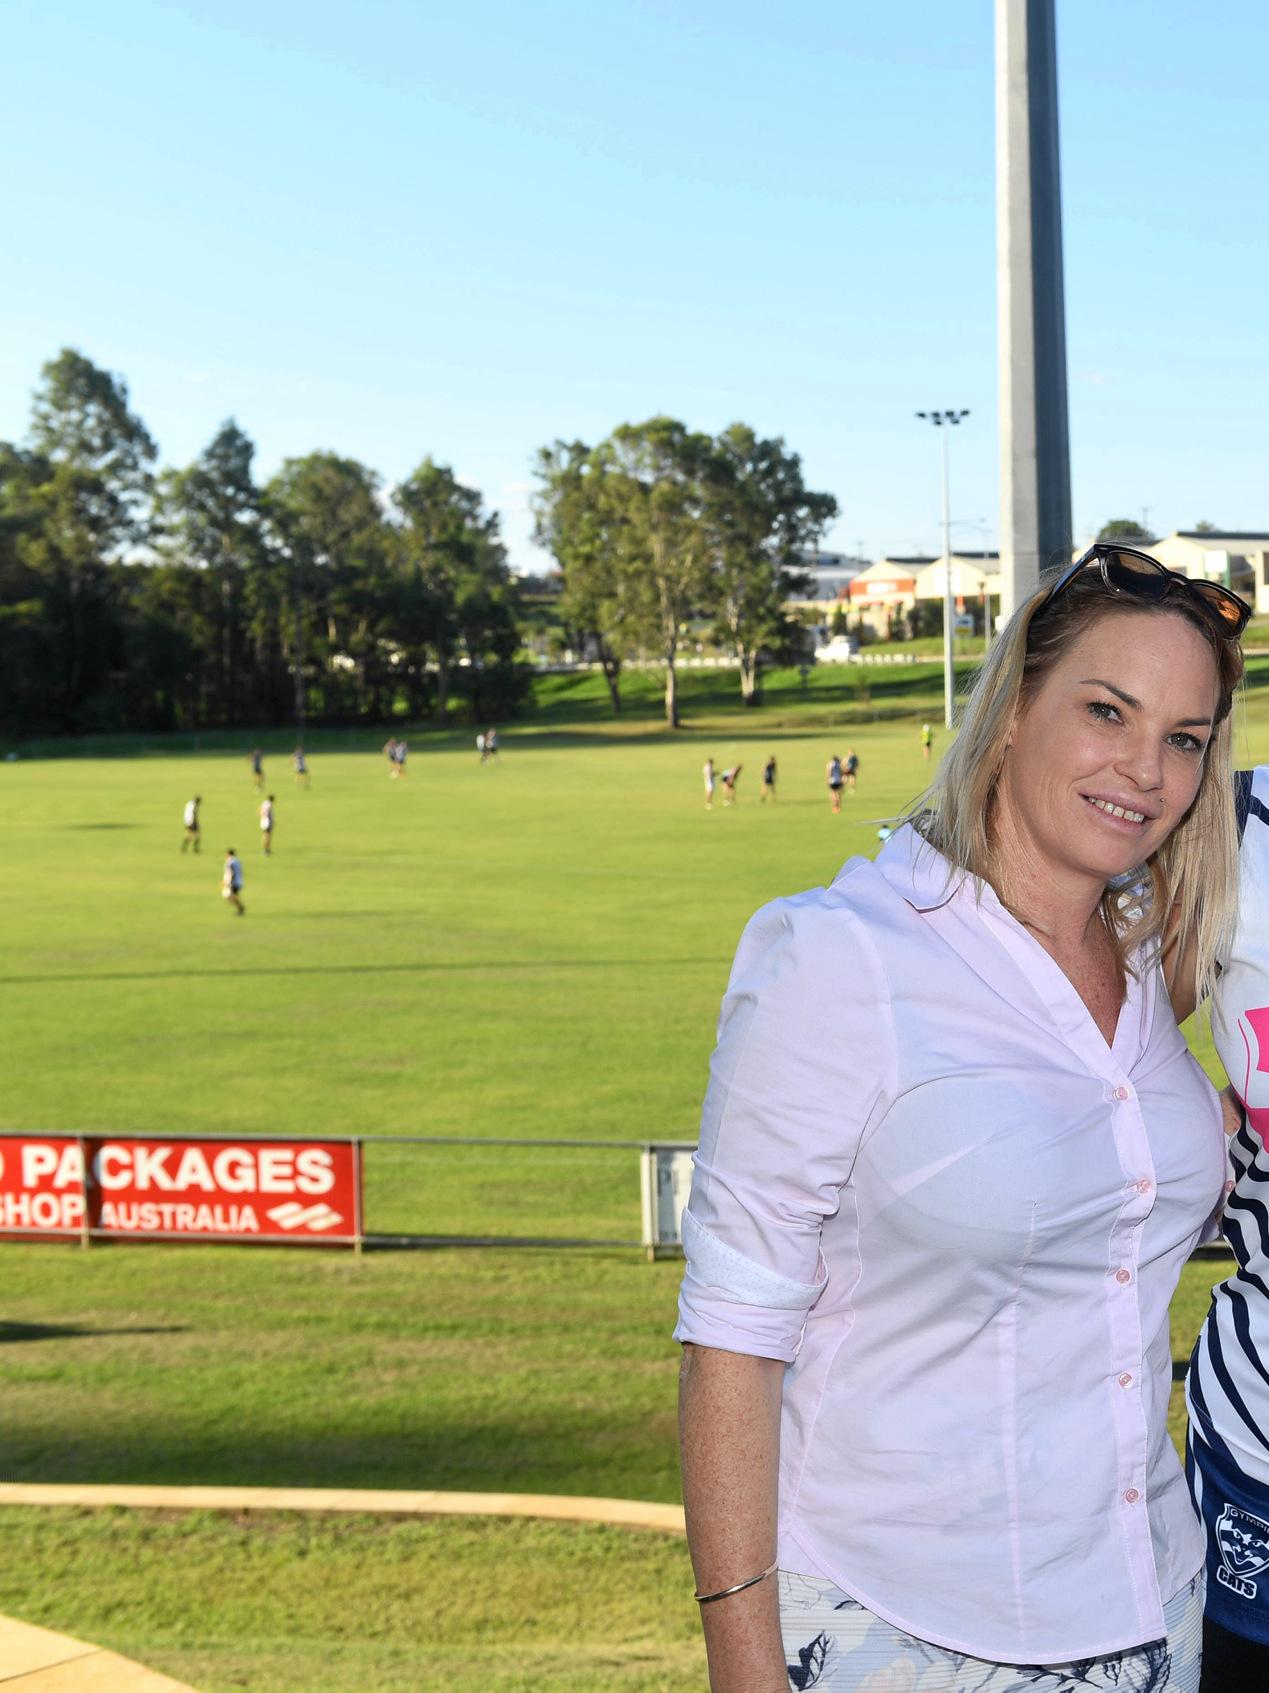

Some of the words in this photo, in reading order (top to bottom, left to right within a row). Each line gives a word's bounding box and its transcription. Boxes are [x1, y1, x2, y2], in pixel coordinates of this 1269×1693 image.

[21, 1144, 336, 1195] PACKAGES
[0, 1192, 87, 1228] HOP
[101, 1201, 260, 1232] AUSTRALIA
[1218, 1567, 1256, 1597] CATS
